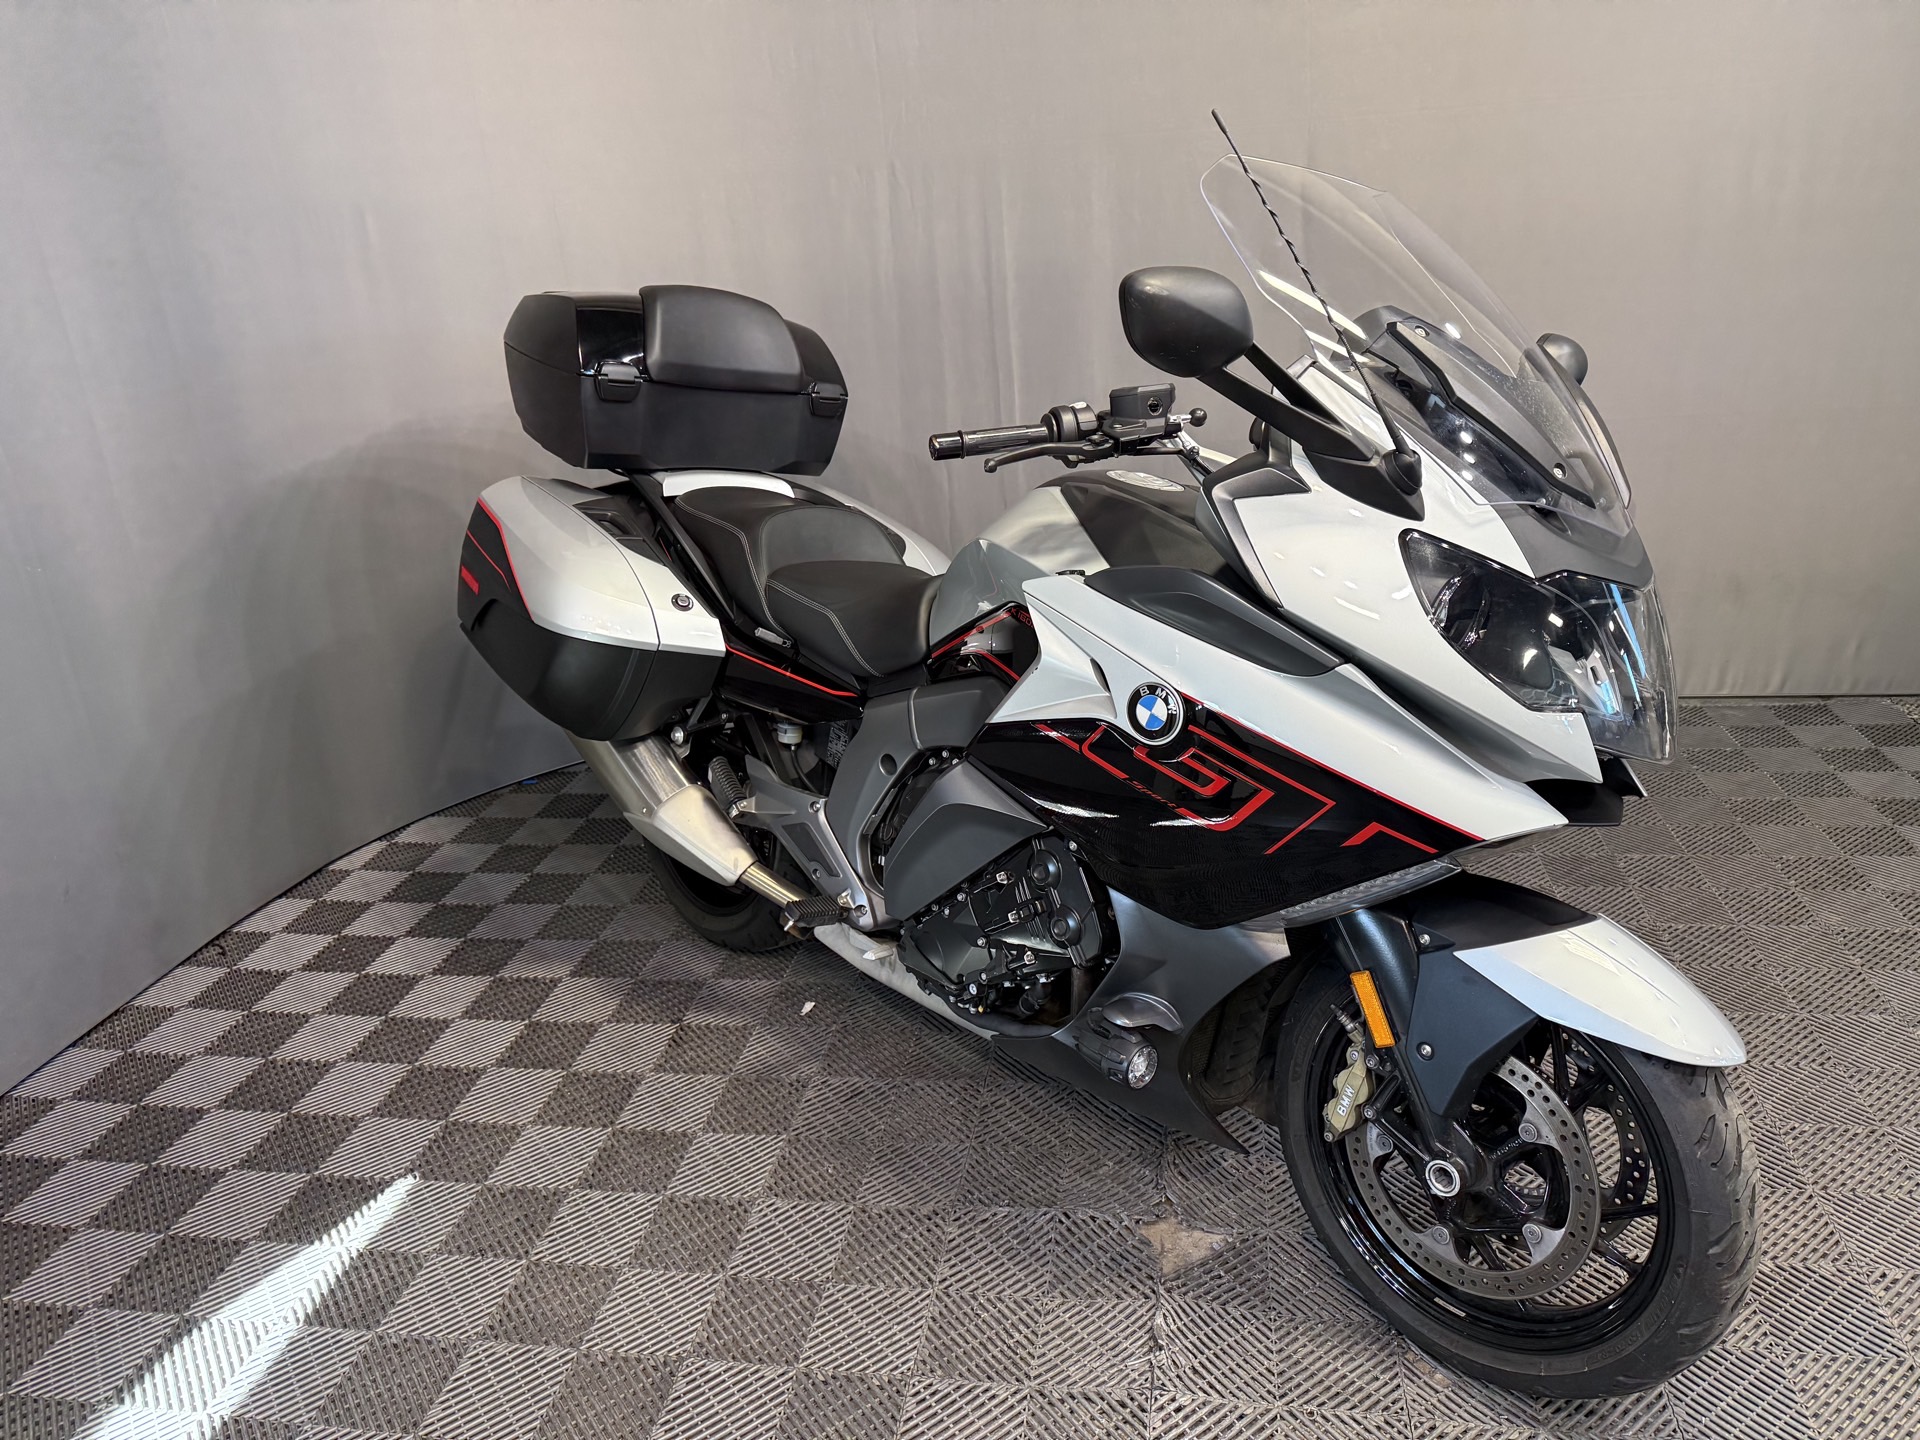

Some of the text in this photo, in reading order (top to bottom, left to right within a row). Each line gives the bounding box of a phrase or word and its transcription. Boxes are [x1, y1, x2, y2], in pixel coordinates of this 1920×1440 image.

[1017, 611, 1034, 629] 160
[1139, 685, 1177, 715] BMW
[1336, 1083, 1355, 1117] BMW
